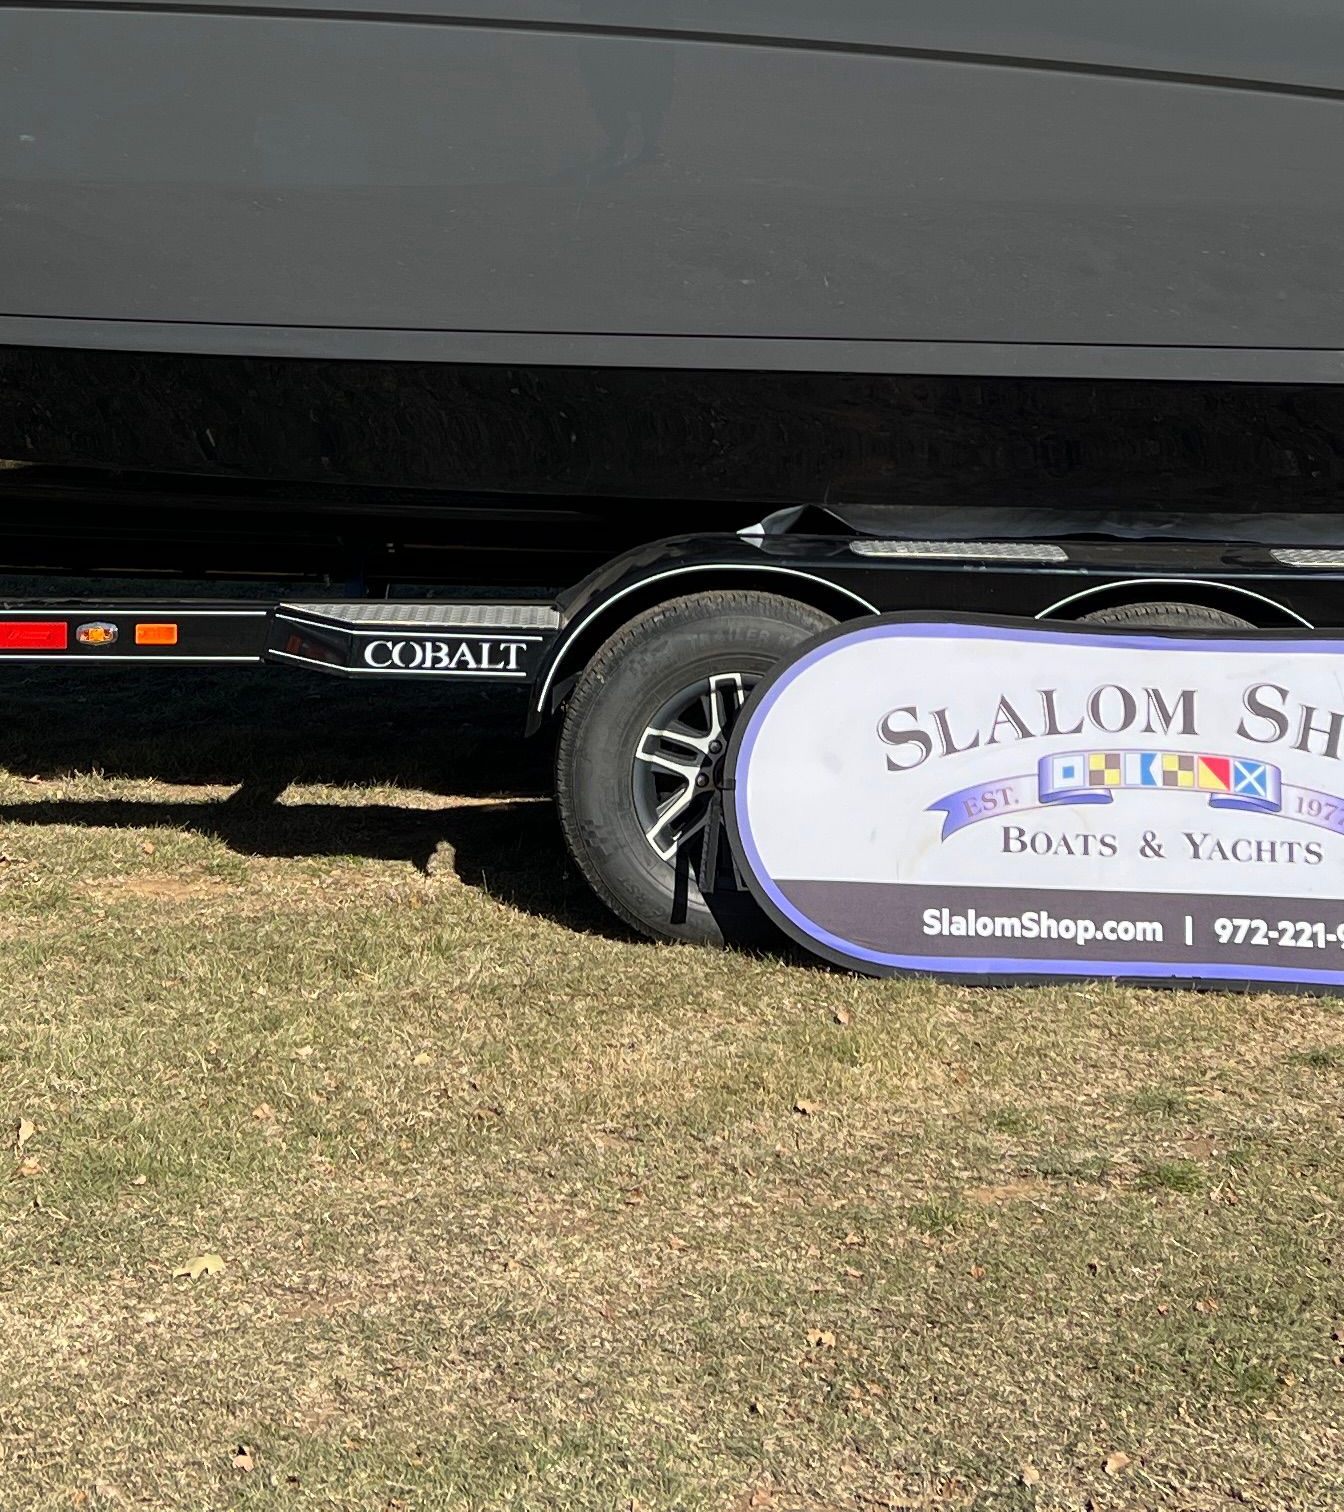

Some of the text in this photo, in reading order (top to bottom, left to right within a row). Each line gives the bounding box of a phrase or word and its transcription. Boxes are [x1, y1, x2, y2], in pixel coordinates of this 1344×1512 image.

[363, 640, 528, 670] COBALT
[876, 684, 1199, 772] SLALOM
[962, 786, 1020, 818] EST.
[1001, 825, 1325, 865] BOATS & YACHTS
[922, 908, 1164, 945] SlalomShop.com
